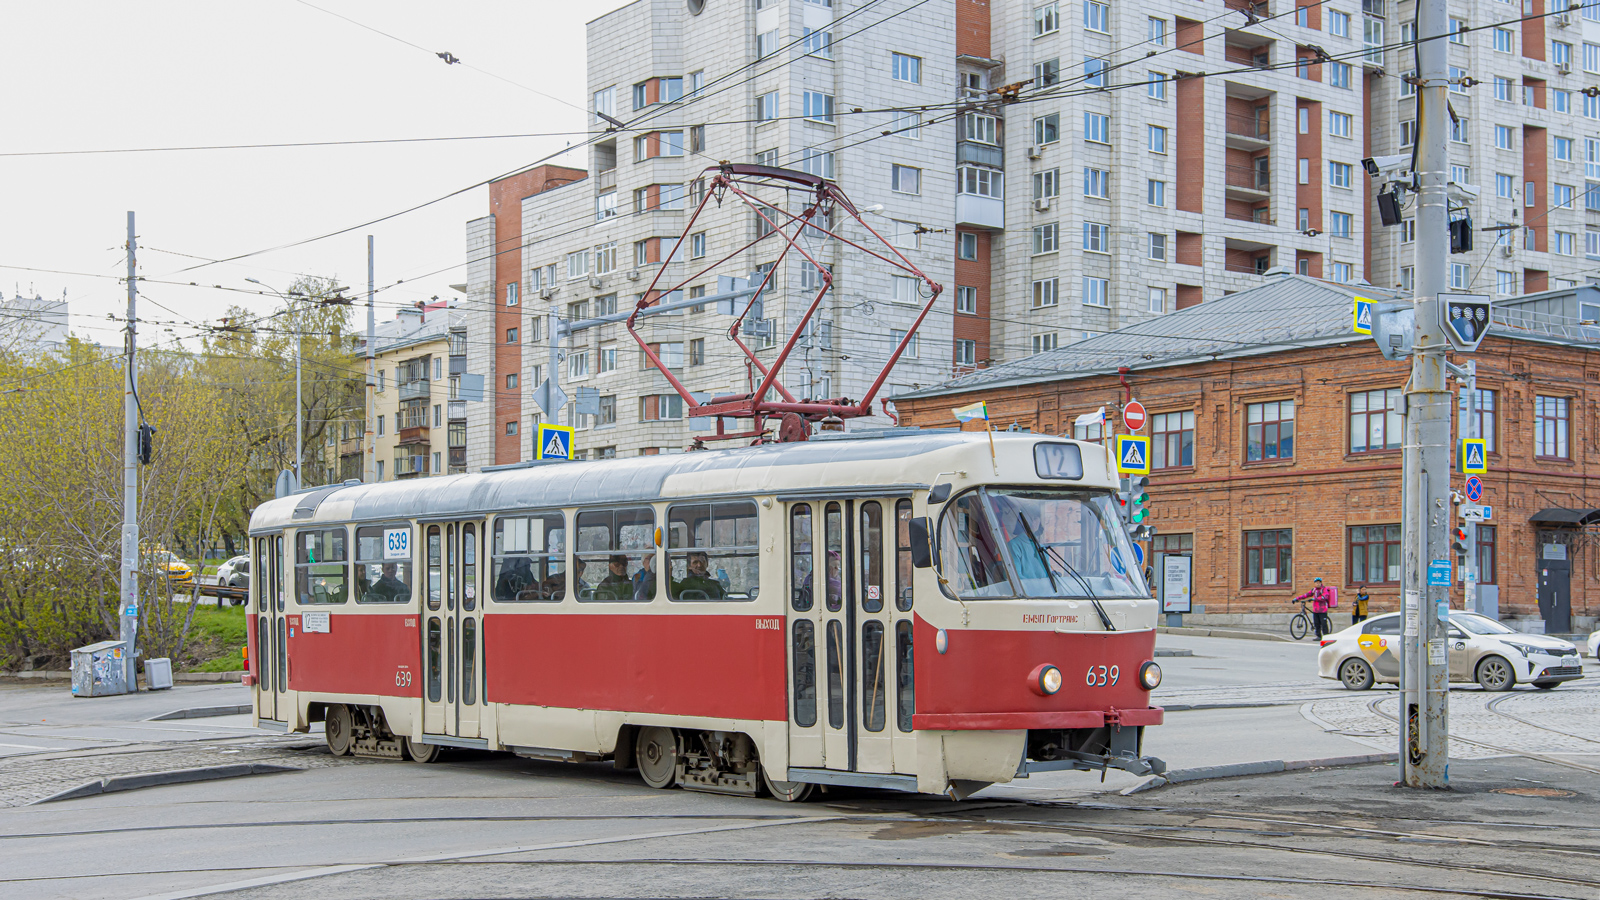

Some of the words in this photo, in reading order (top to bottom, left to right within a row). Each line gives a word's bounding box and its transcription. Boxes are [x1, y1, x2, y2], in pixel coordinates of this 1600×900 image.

[1042, 446, 1068, 476] 12
[388, 532, 407, 550] 639
[755, 618, 780, 630] ВЫХОД
[1022, 614, 1045, 624] ЕМУП
[395, 671, 412, 688] 639
[1086, 665, 1120, 687] 639
